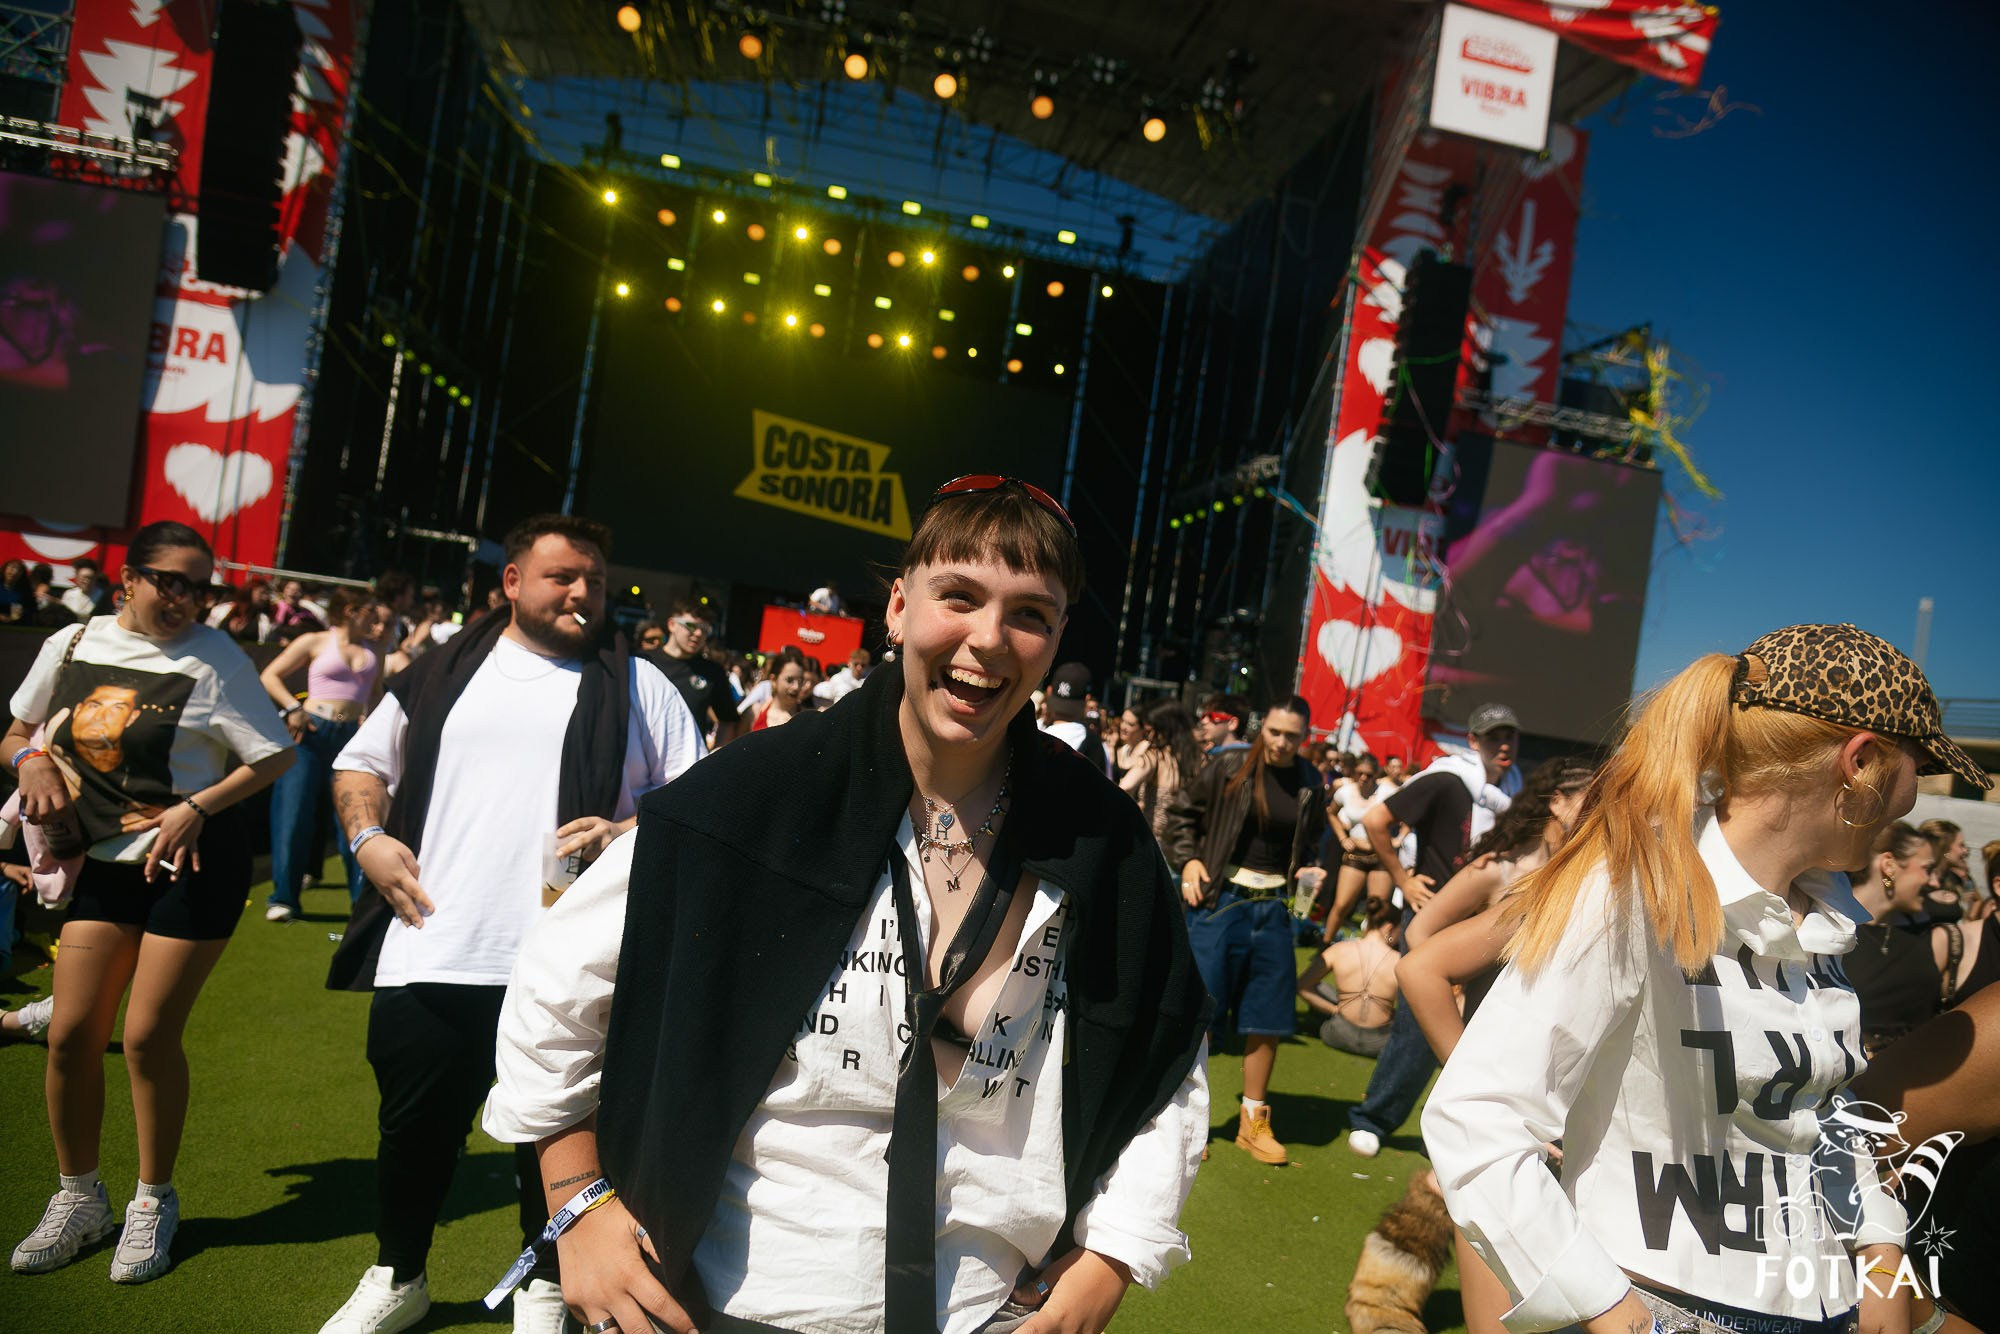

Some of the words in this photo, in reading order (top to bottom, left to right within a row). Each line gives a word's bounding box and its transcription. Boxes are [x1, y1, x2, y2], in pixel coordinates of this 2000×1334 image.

[1462, 77, 1526, 107] VIBRA
[762, 424, 872, 473] COSTA
[758, 473, 893, 527] SONORA
